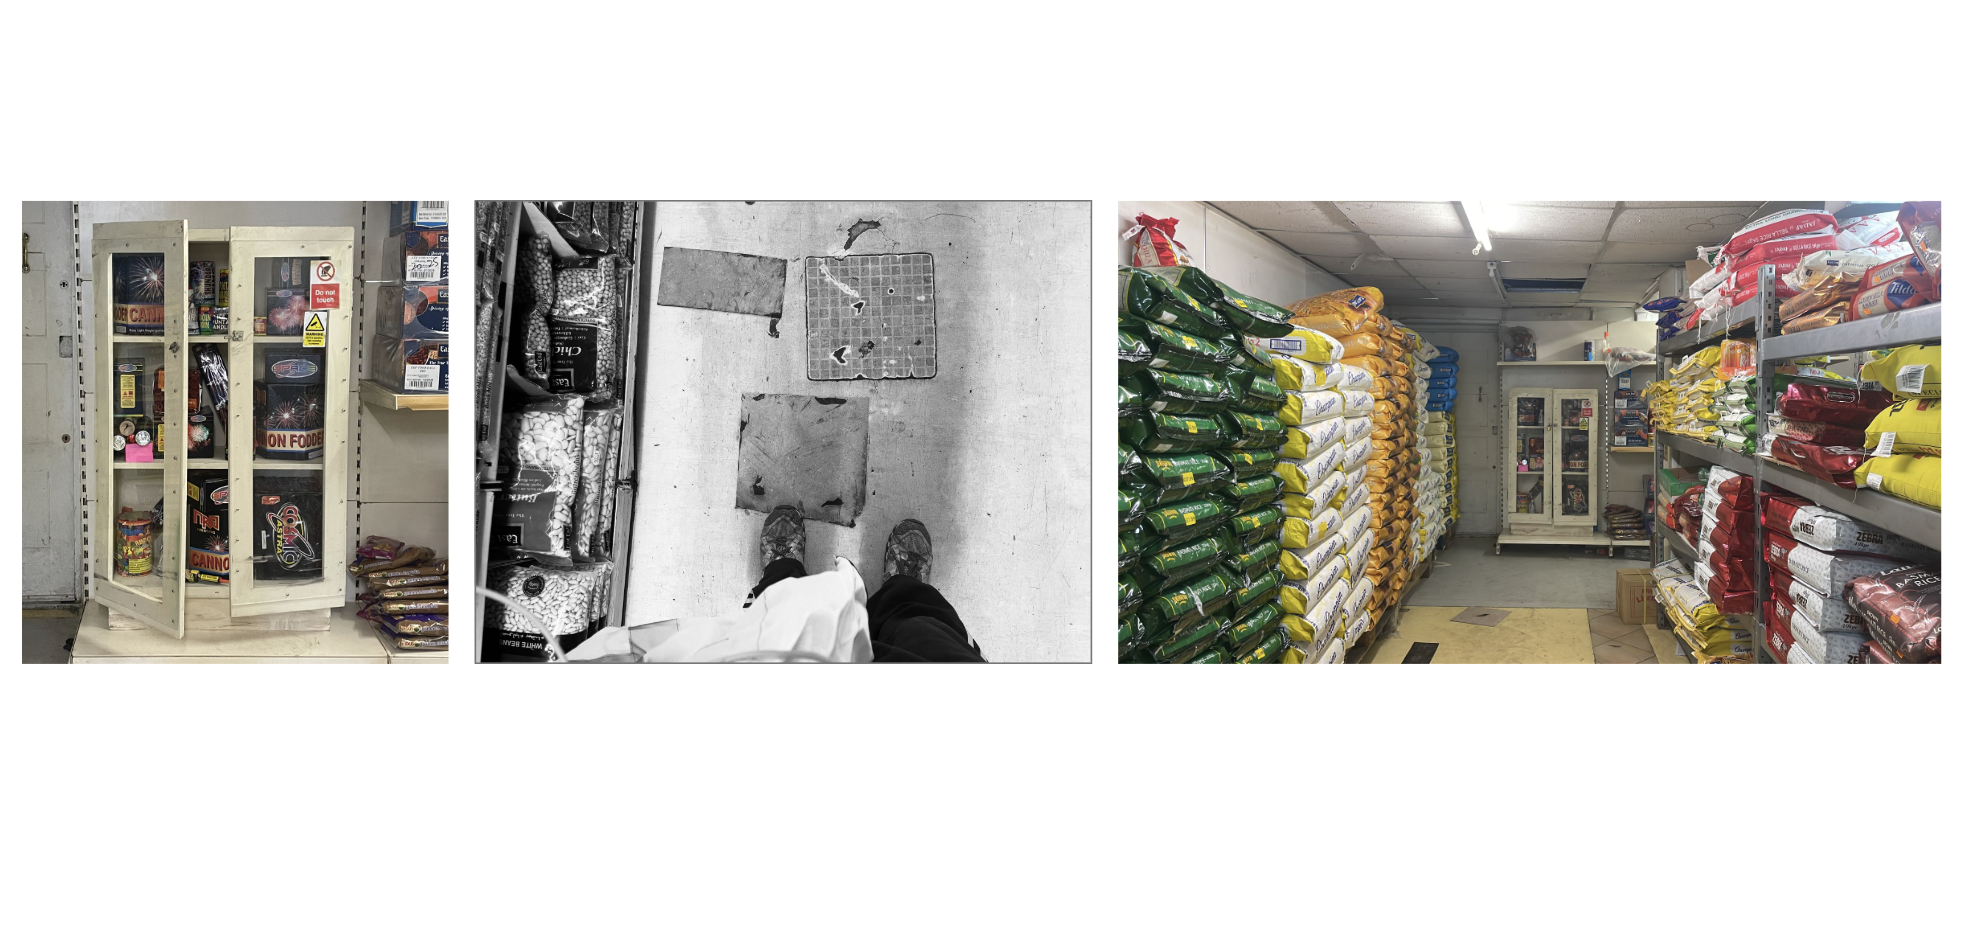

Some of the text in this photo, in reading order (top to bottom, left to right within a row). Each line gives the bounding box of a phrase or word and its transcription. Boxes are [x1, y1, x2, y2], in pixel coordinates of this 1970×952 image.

[283, 506, 299, 562] COSMIC
[1856, 531, 1884, 545] ZEBRA
[1914, 575, 1941, 587] RICE
[521, 641, 543, 650] WHITE
